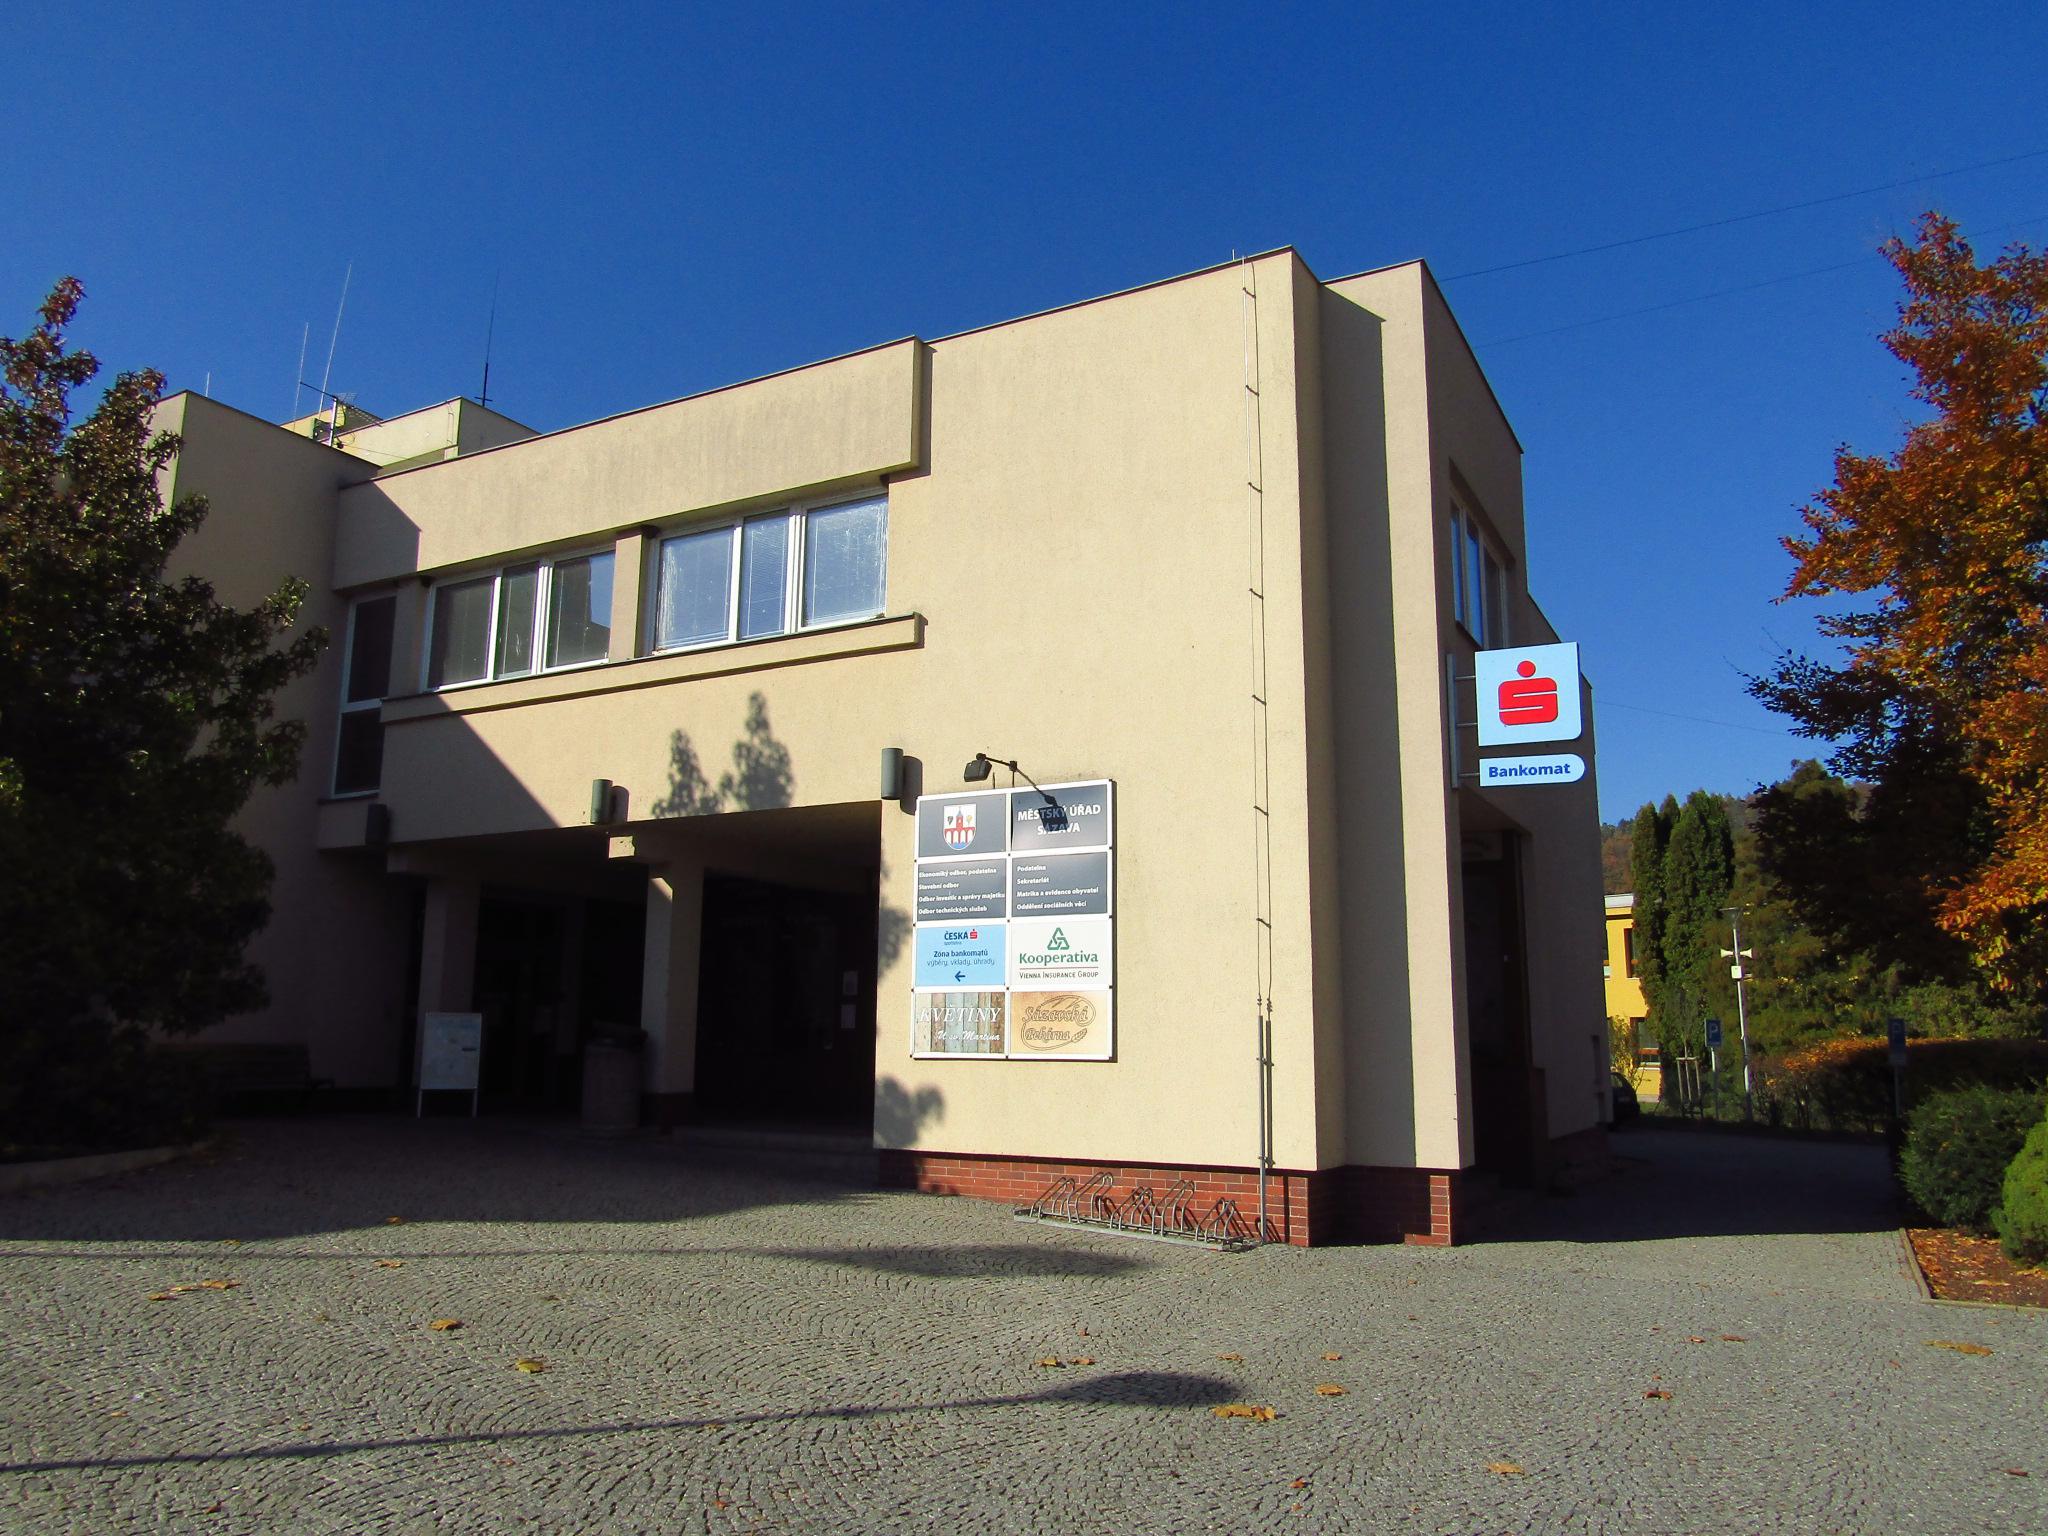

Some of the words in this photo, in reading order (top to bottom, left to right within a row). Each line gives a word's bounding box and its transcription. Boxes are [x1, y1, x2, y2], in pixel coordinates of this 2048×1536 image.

[1488, 763, 1571, 778] Bankomat
[1017, 805, 1067, 821] MĚSTSKÝ
[1069, 803, 1101, 817] ÚŘAD
[1037, 822, 1081, 835] SÁZAVA
[1016, 877, 1050, 885] Sekretariát
[1072, 886, 1099, 895] obyvatel
[936, 894, 957, 902] investic
[962, 893, 981, 901] správy
[981, 892, 1005, 900] majetku
[936, 906, 969, 914] technických
[1044, 901, 1073, 909] sociálních
[933, 950, 950, 958] Zóna
[951, 948, 988, 957] bankomatů
[1019, 950, 1099, 966] Kooperativa
[973, 958, 995, 966] úhrady
[1043, 971, 1076, 979] INSURANCE
[1078, 970, 1099, 978] GROUP
[920, 1004, 1002, 1023] KVĚTINY
[1021, 1003, 1089, 1022] Sázavská
